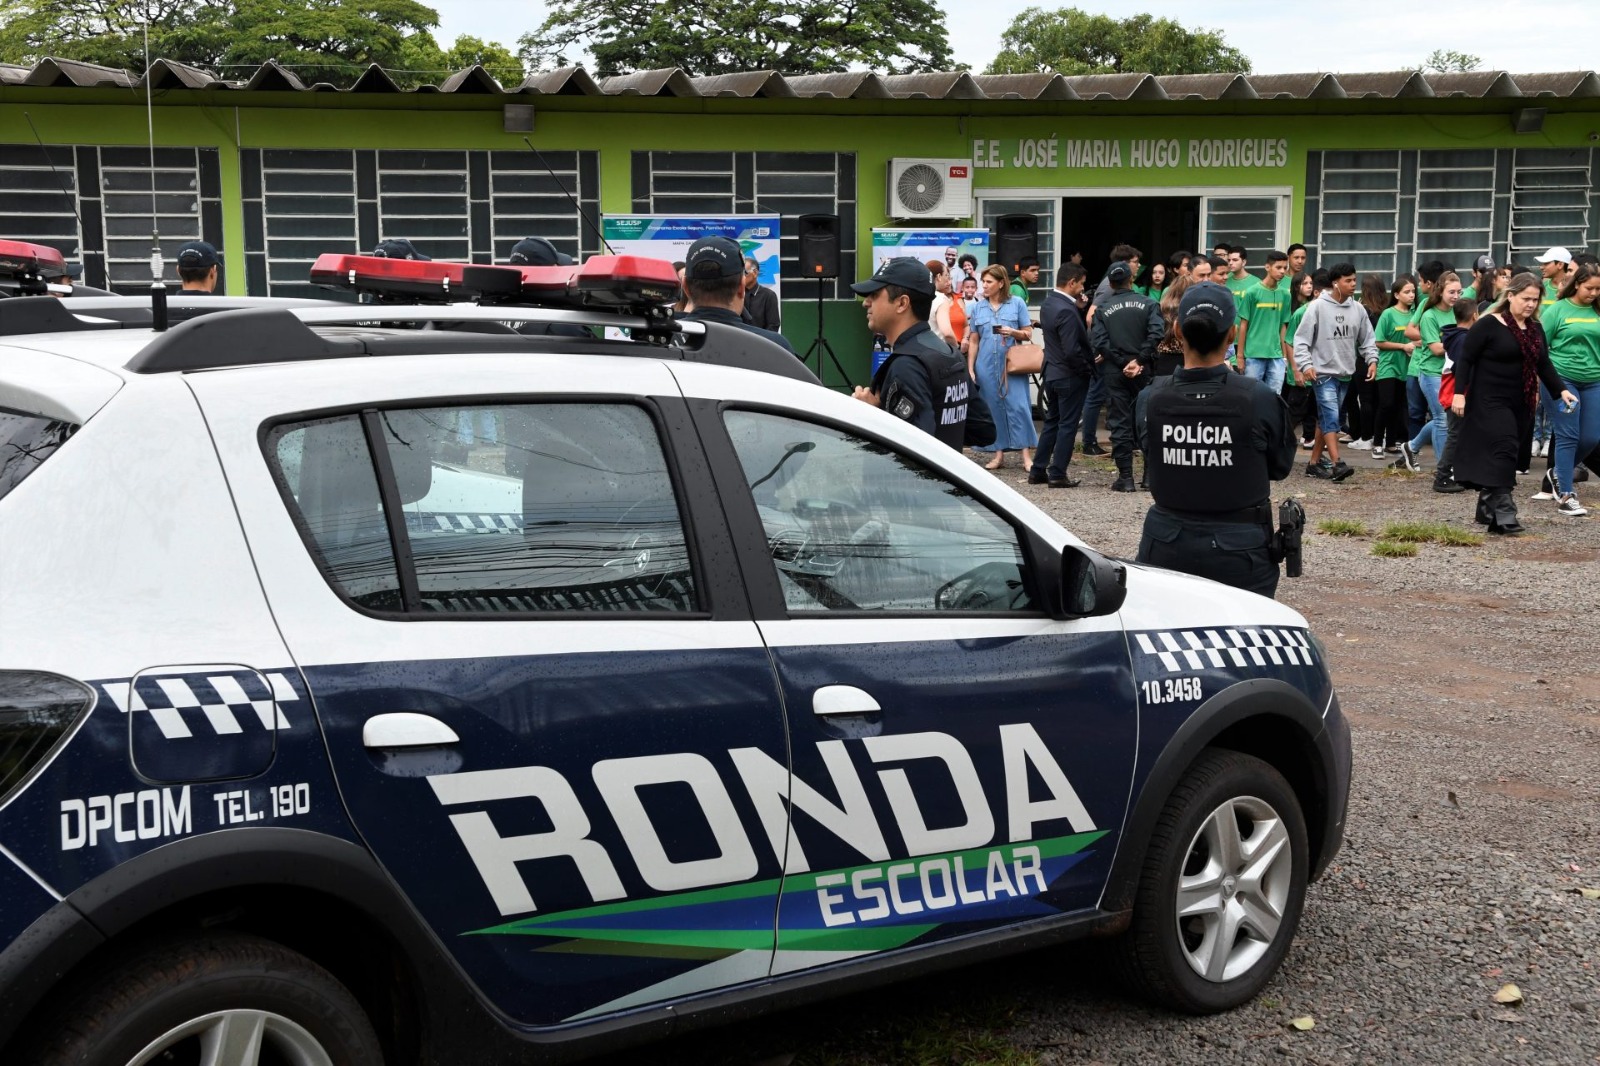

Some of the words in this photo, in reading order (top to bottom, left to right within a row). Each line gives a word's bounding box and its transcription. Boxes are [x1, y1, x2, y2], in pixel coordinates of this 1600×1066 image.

[973, 139, 1004, 168] E.E.
[1013, 133, 1058, 168] JOSÉ
[1066, 139, 1122, 168] MARIA
[1130, 138, 1181, 168] HUGO
[1188, 138, 1288, 168] RODRIGUES
[1103, 302, 1124, 318] POLÍCIA
[1124, 301, 1146, 311] MILITAR
[944, 380, 969, 403] POLÍCIA
[1162, 422, 1233, 445] POLÍCIA
[1163, 447, 1234, 467] MILITAR
[1141, 677, 1202, 705] 10.3458
[60, 785, 192, 851] DPCOM
[213, 790, 264, 825] TEL.
[270, 782, 310, 818] 190
[426, 722, 1098, 916] RONDA
[814, 845, 1049, 928] ESCOLAR
